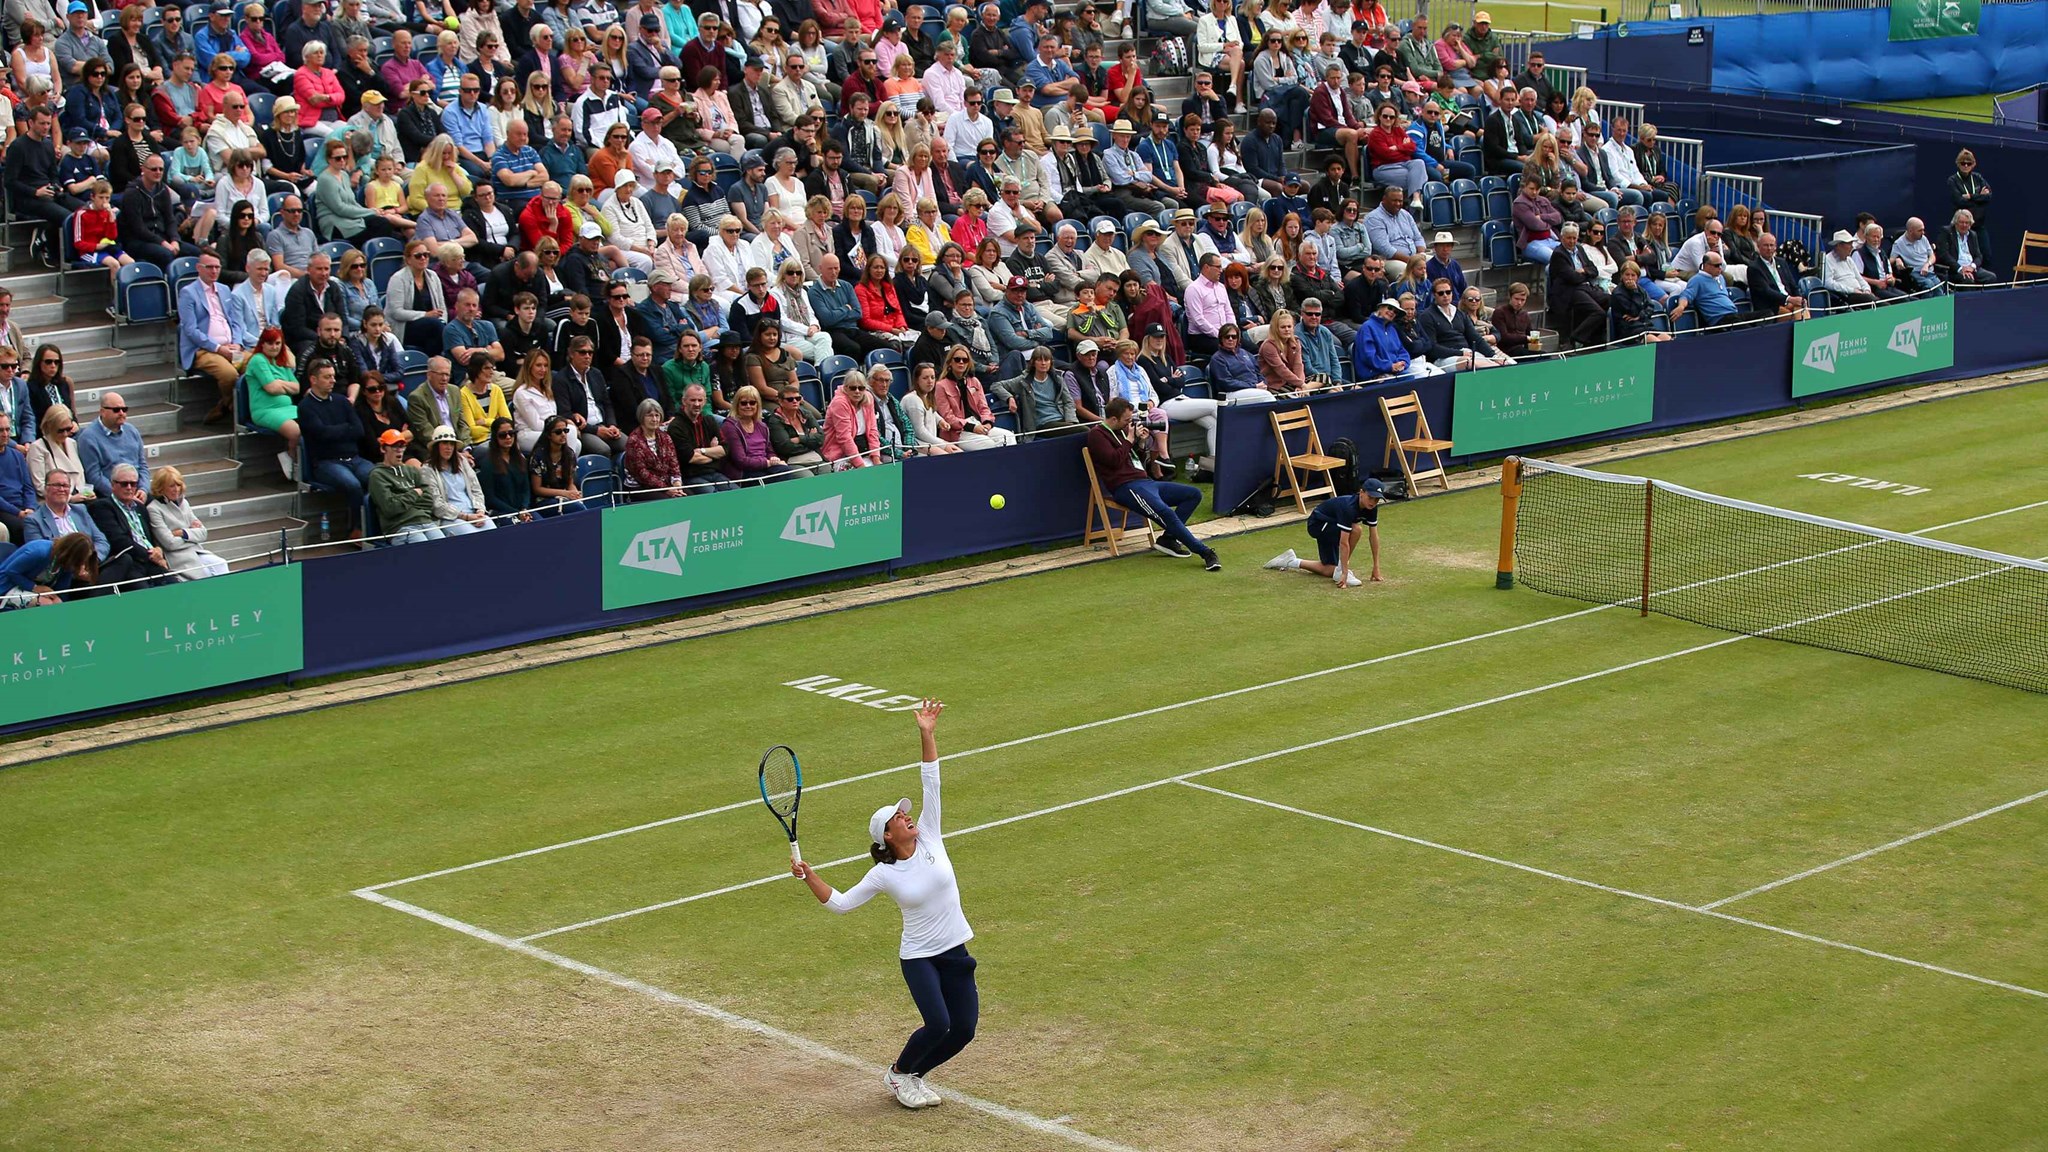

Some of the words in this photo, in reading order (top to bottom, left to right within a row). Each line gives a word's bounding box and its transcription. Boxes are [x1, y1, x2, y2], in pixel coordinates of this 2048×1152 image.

[1896, 329, 1919, 347] LTA
[1922, 321, 1948, 334] TENNIS
[1811, 344, 1836, 363] LTA
[1839, 336, 1867, 350] TENNIS
[1574, 375, 1636, 396] ILKLEY
[1479, 390, 1550, 411] ILKLEY
[1589, 393, 1621, 405] TROPHY
[1496, 408, 1533, 421] TROPHY
[1796, 472, 1933, 496] ILKLEY
[795, 509, 837, 537] LTA
[843, 499, 890, 517] TENNIS
[844, 517, 860, 527] FOR
[861, 512, 890, 524] BRITAIN
[637, 536, 686, 564] LTA
[692, 525, 744, 543] TENNIS
[693, 544, 710, 554] FOR
[712, 539, 743, 551] BRITAIN
[145, 609, 263, 643] ILKLEY
[174, 634, 237, 654] TROPHY
[1, 664, 66, 685] TROPHY
[780, 674, 948, 712] ILKLEY
